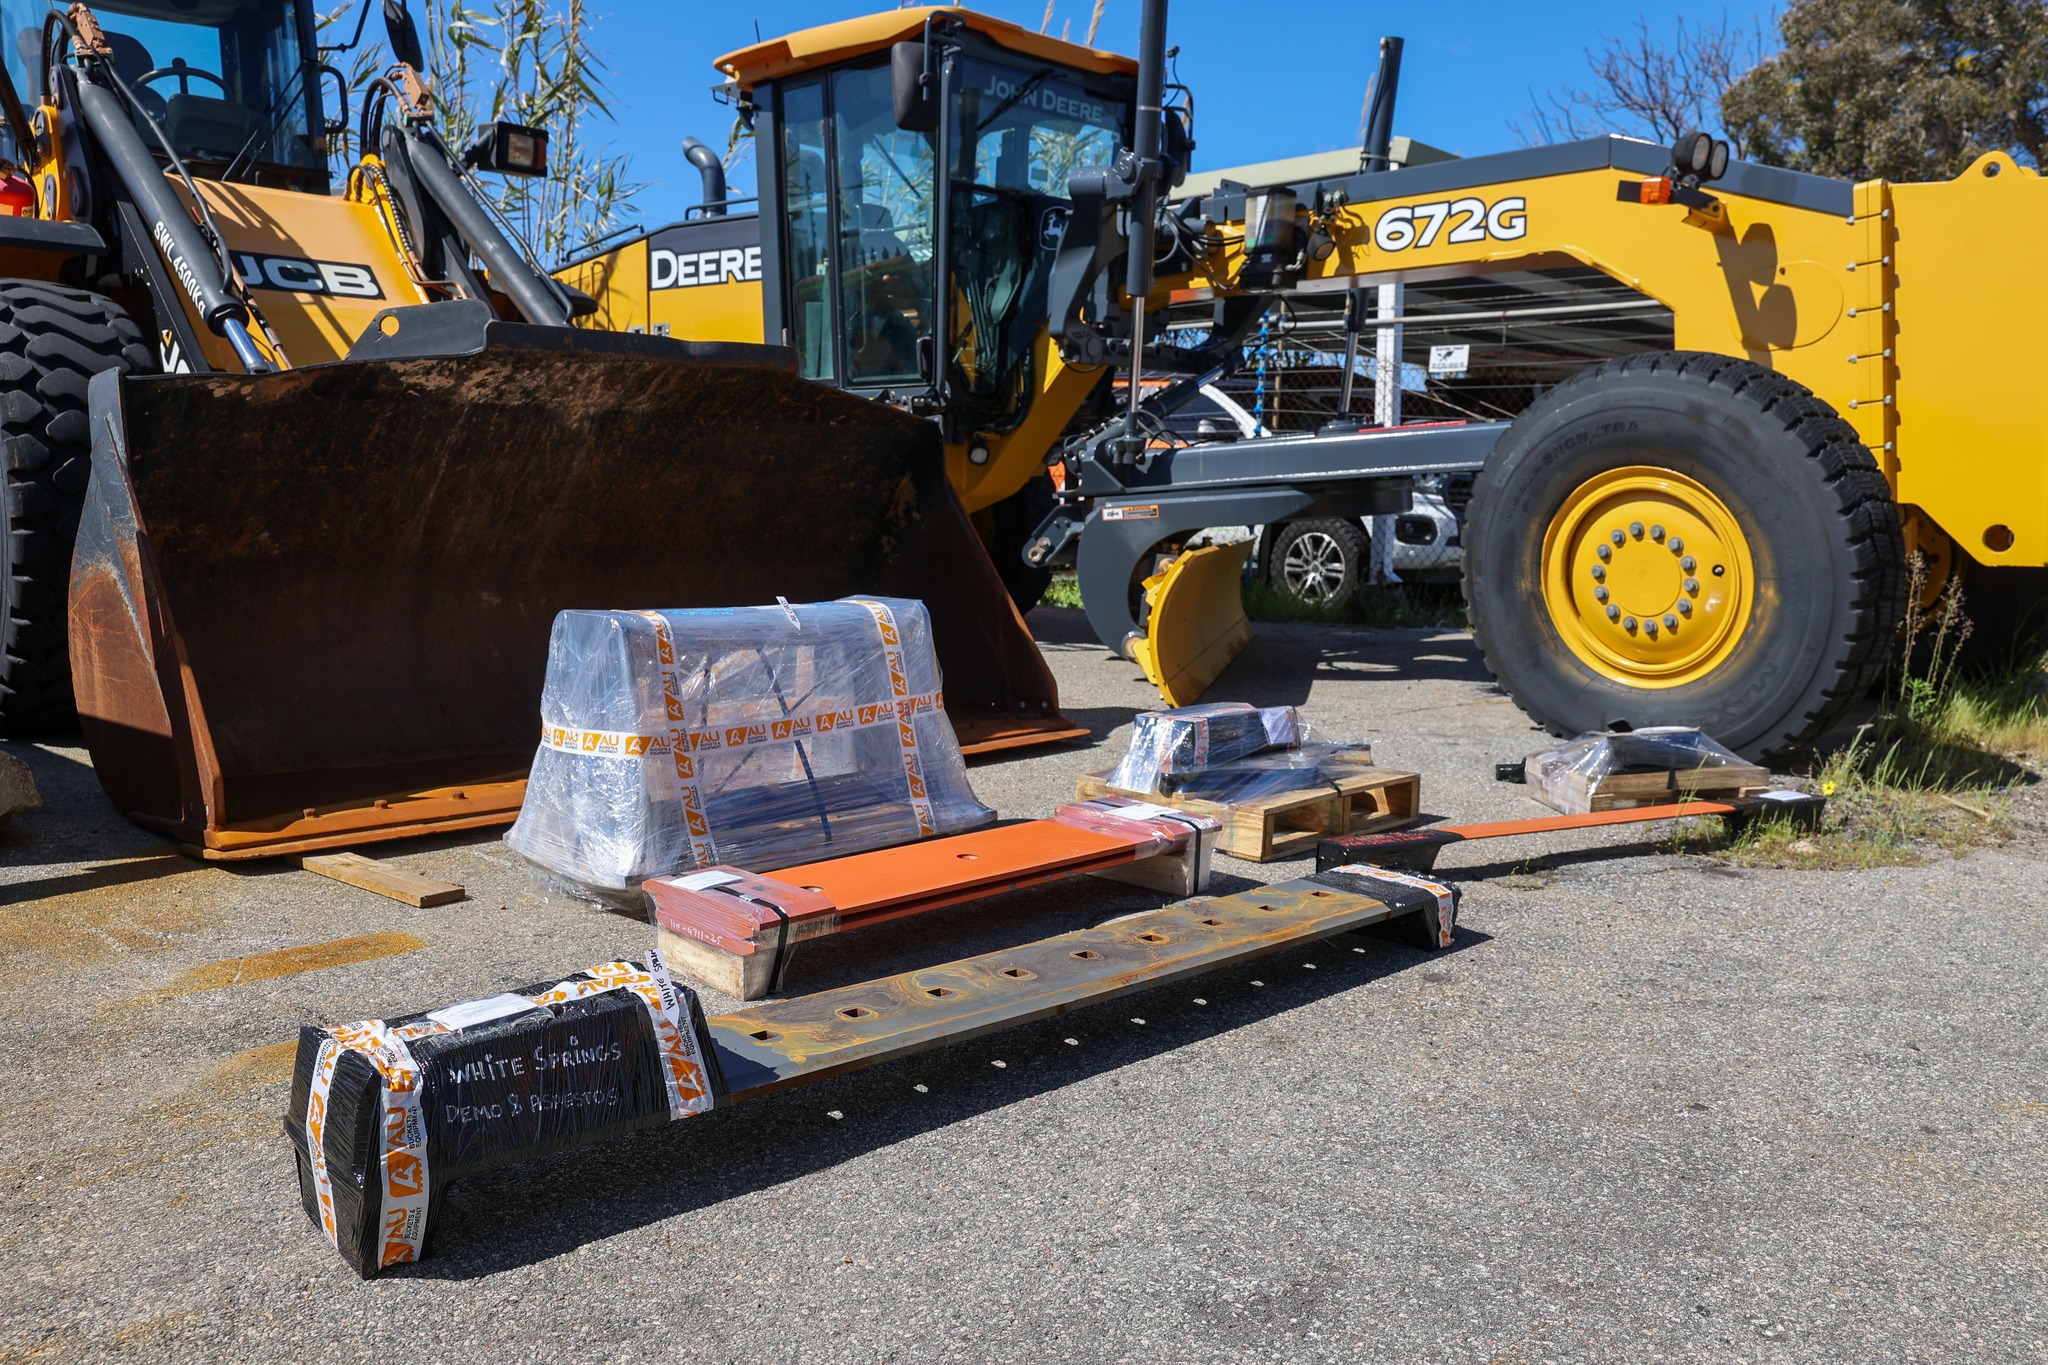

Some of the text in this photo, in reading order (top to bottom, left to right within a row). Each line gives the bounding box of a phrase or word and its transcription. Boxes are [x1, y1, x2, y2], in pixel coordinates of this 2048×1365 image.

[984, 75, 1103, 122] JOHN DEERE
[1375, 197, 1527, 252] 672G
[154, 221, 175, 263] SWL
[240, 255, 379, 297] JCB
[651, 246, 762, 289] DEERE
[887, 651, 899, 672] AU
[878, 702, 894, 714] AU
[916, 695, 931, 707] AU
[793, 717, 811, 729] AU
[836, 710, 853, 722] AU
[565, 731, 578, 743] AU
[600, 734, 619, 746] AU
[651, 736, 670, 747] AU
[670, 729, 683, 752] AU
[701, 730, 720, 743] AU
[748, 724, 766, 736] AU
[904, 753, 916, 774] AU
[681, 786, 696, 809] AU
[915, 804, 929, 825] AU
[656, 977, 677, 1011] WHITE
[659, 1020, 686, 1056] AU
[681, 1016, 696, 1055] EQUIPMENT
[446, 1103, 503, 1124] DEMO
[507, 1092, 524, 1117] &
[387, 1106, 408, 1149] AU
[406, 1114, 416, 1149] BUCKETS
[411, 1105, 422, 1148] EQUIPMENT
[386, 1207, 408, 1239] AU
[404, 1214, 415, 1239] BUCKETS
[411, 1206, 422, 1241] EQUIPMENT
